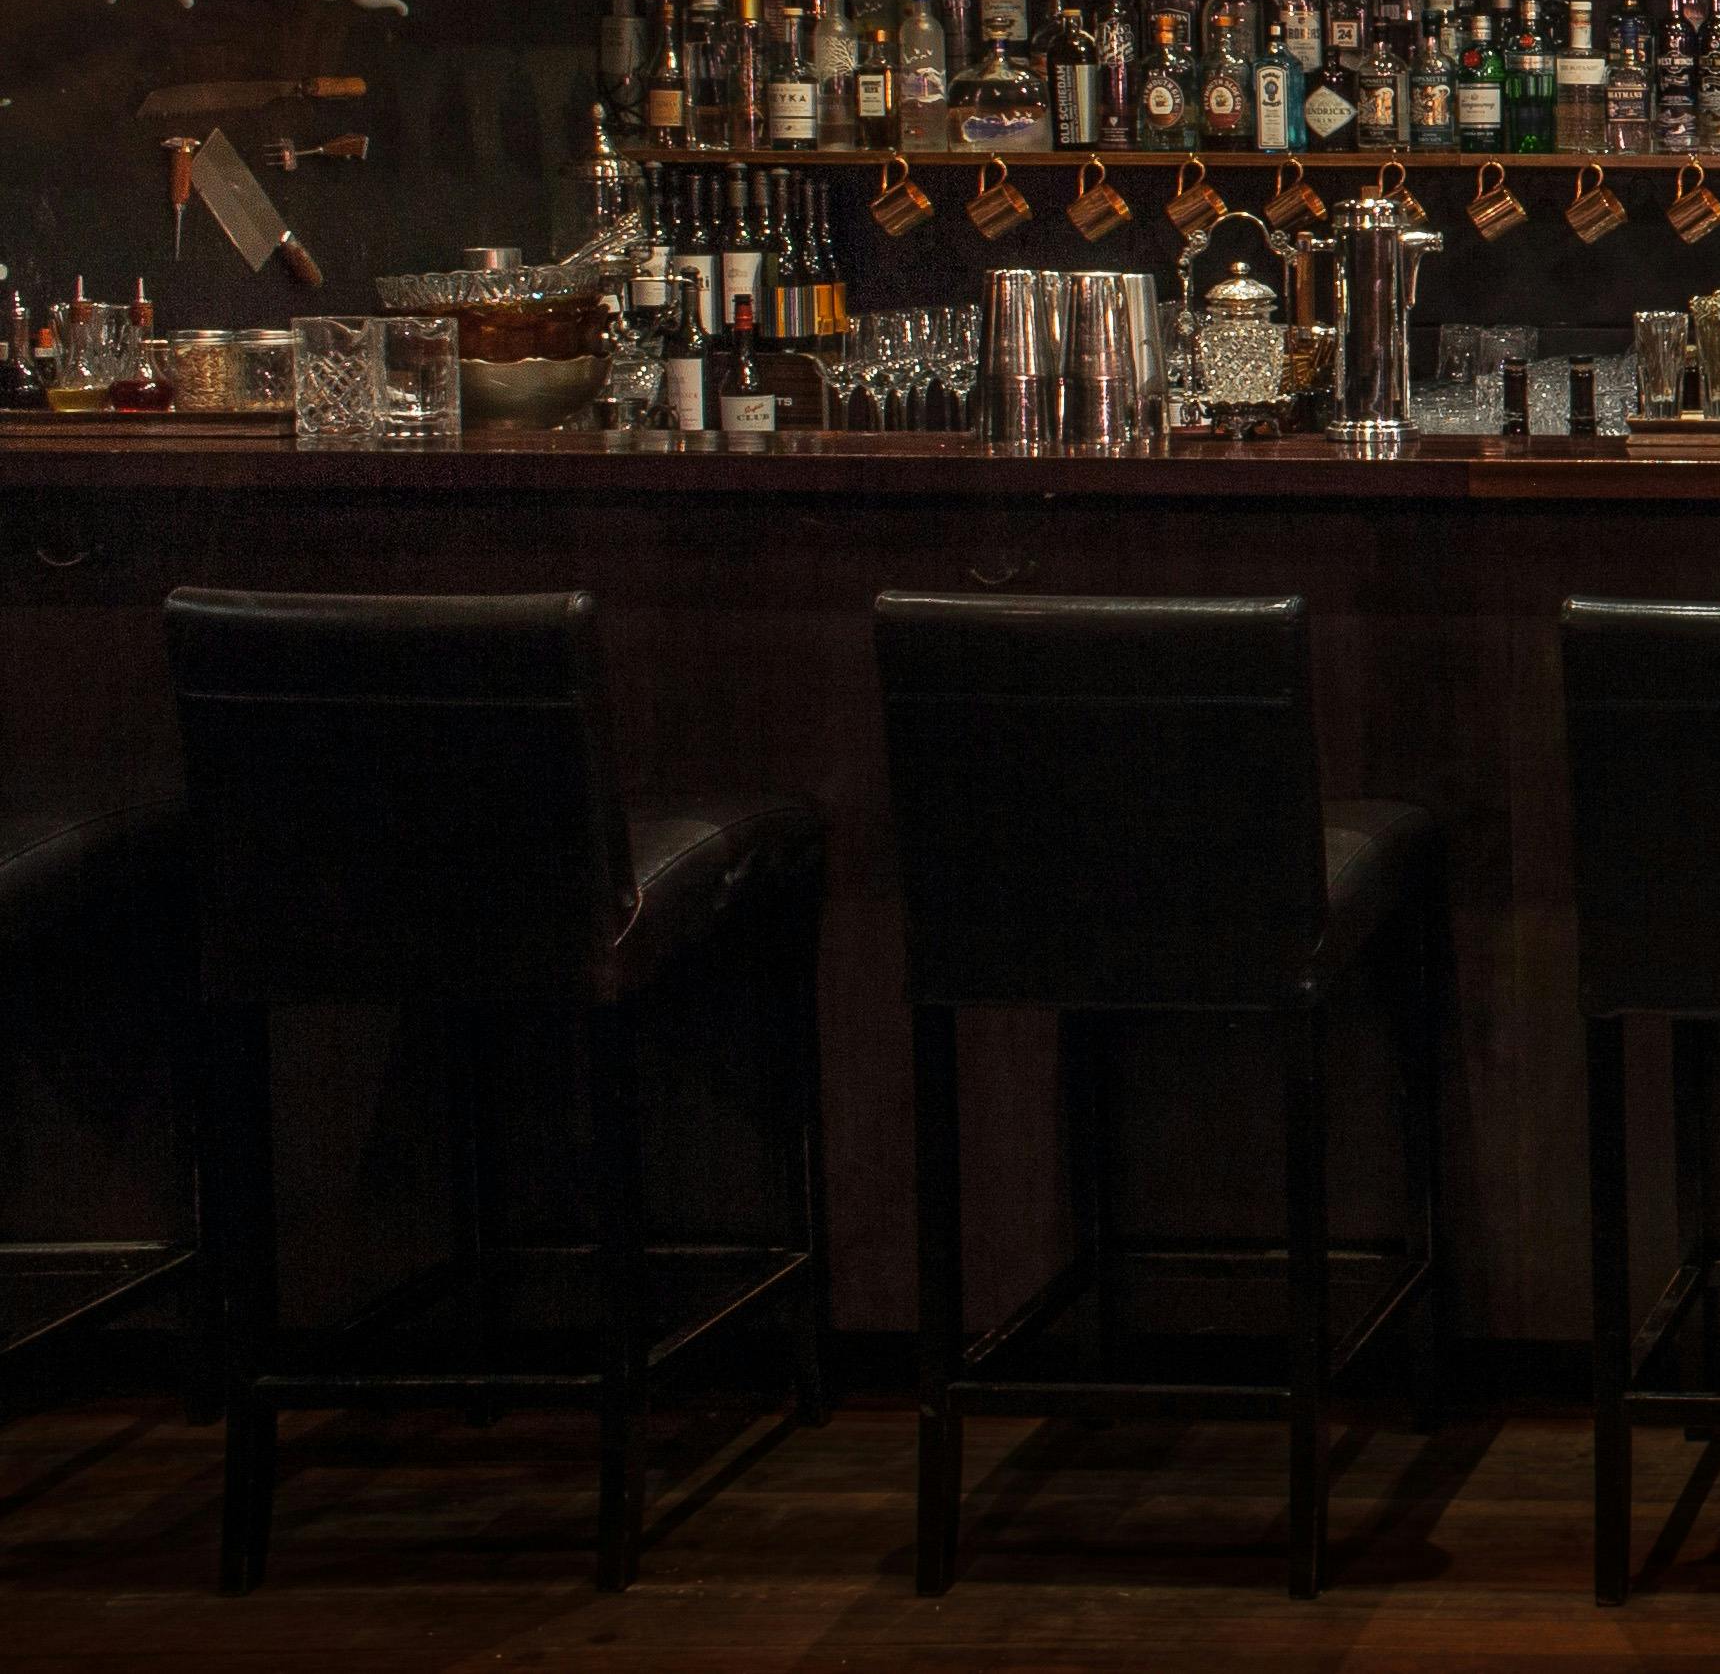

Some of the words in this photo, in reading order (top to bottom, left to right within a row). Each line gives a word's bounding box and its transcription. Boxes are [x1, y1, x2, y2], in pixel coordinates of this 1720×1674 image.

[1337, 28, 1354, 41] 24
[1061, 63, 1071, 120] SCHIEDAM
[1061, 122, 1071, 144] OLD
